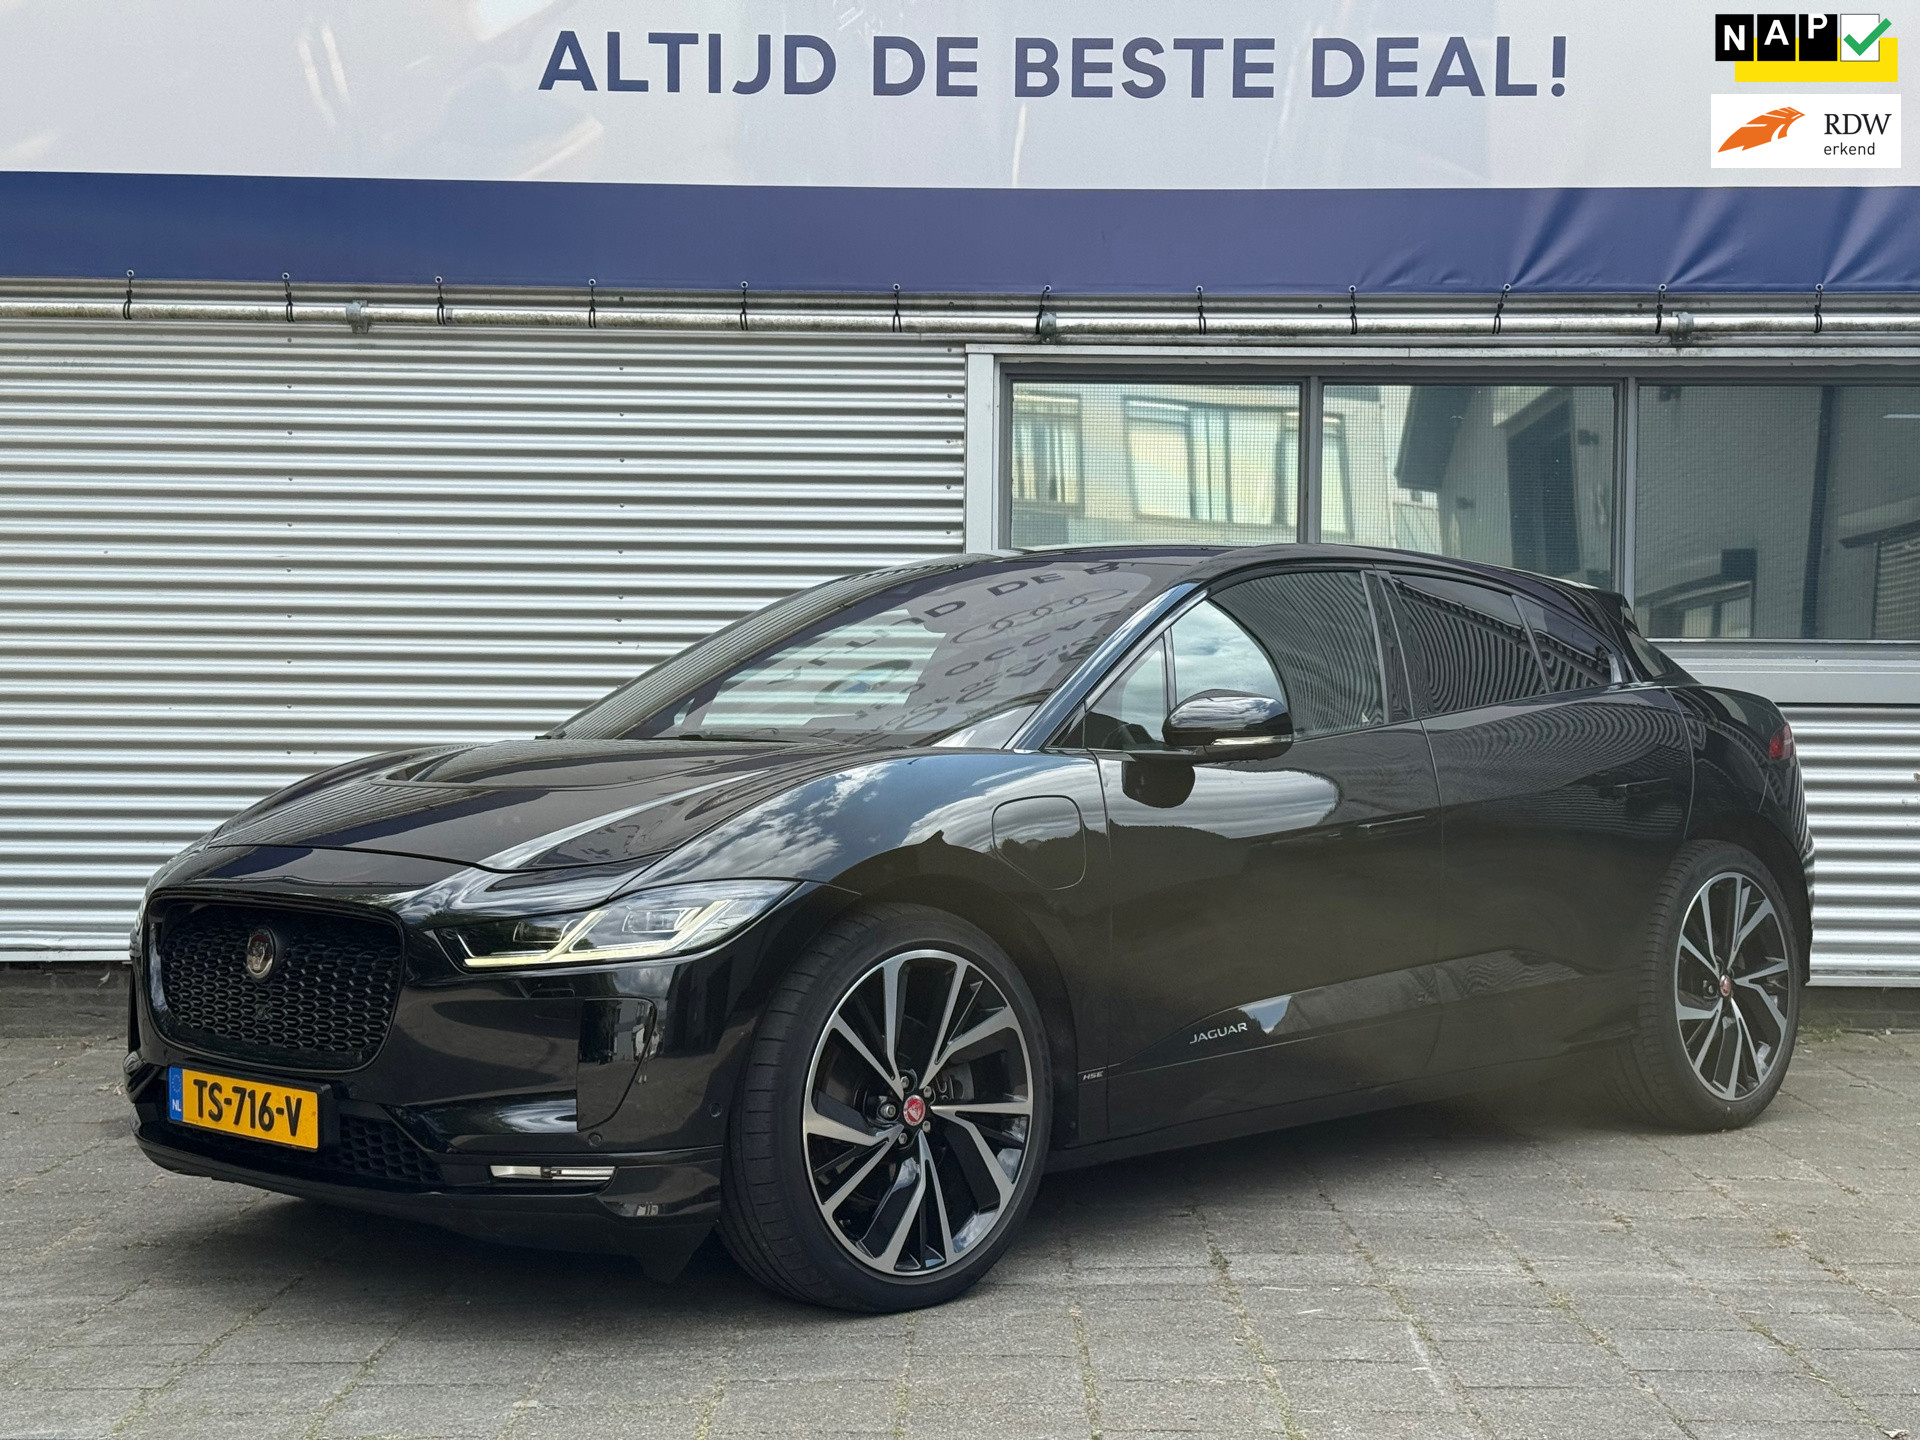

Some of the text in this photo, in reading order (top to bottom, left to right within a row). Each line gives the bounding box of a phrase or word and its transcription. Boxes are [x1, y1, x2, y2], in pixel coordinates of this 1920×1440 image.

[538, 30, 1567, 99] ALTIJD DE BESTE DEAL!
[1189, 1022, 1248, 1045] JAGUAR
[1083, 1070, 1104, 1080] HSE
[172, 1098, 182, 1112] NL
[193, 1079, 302, 1137] TS-716-V
